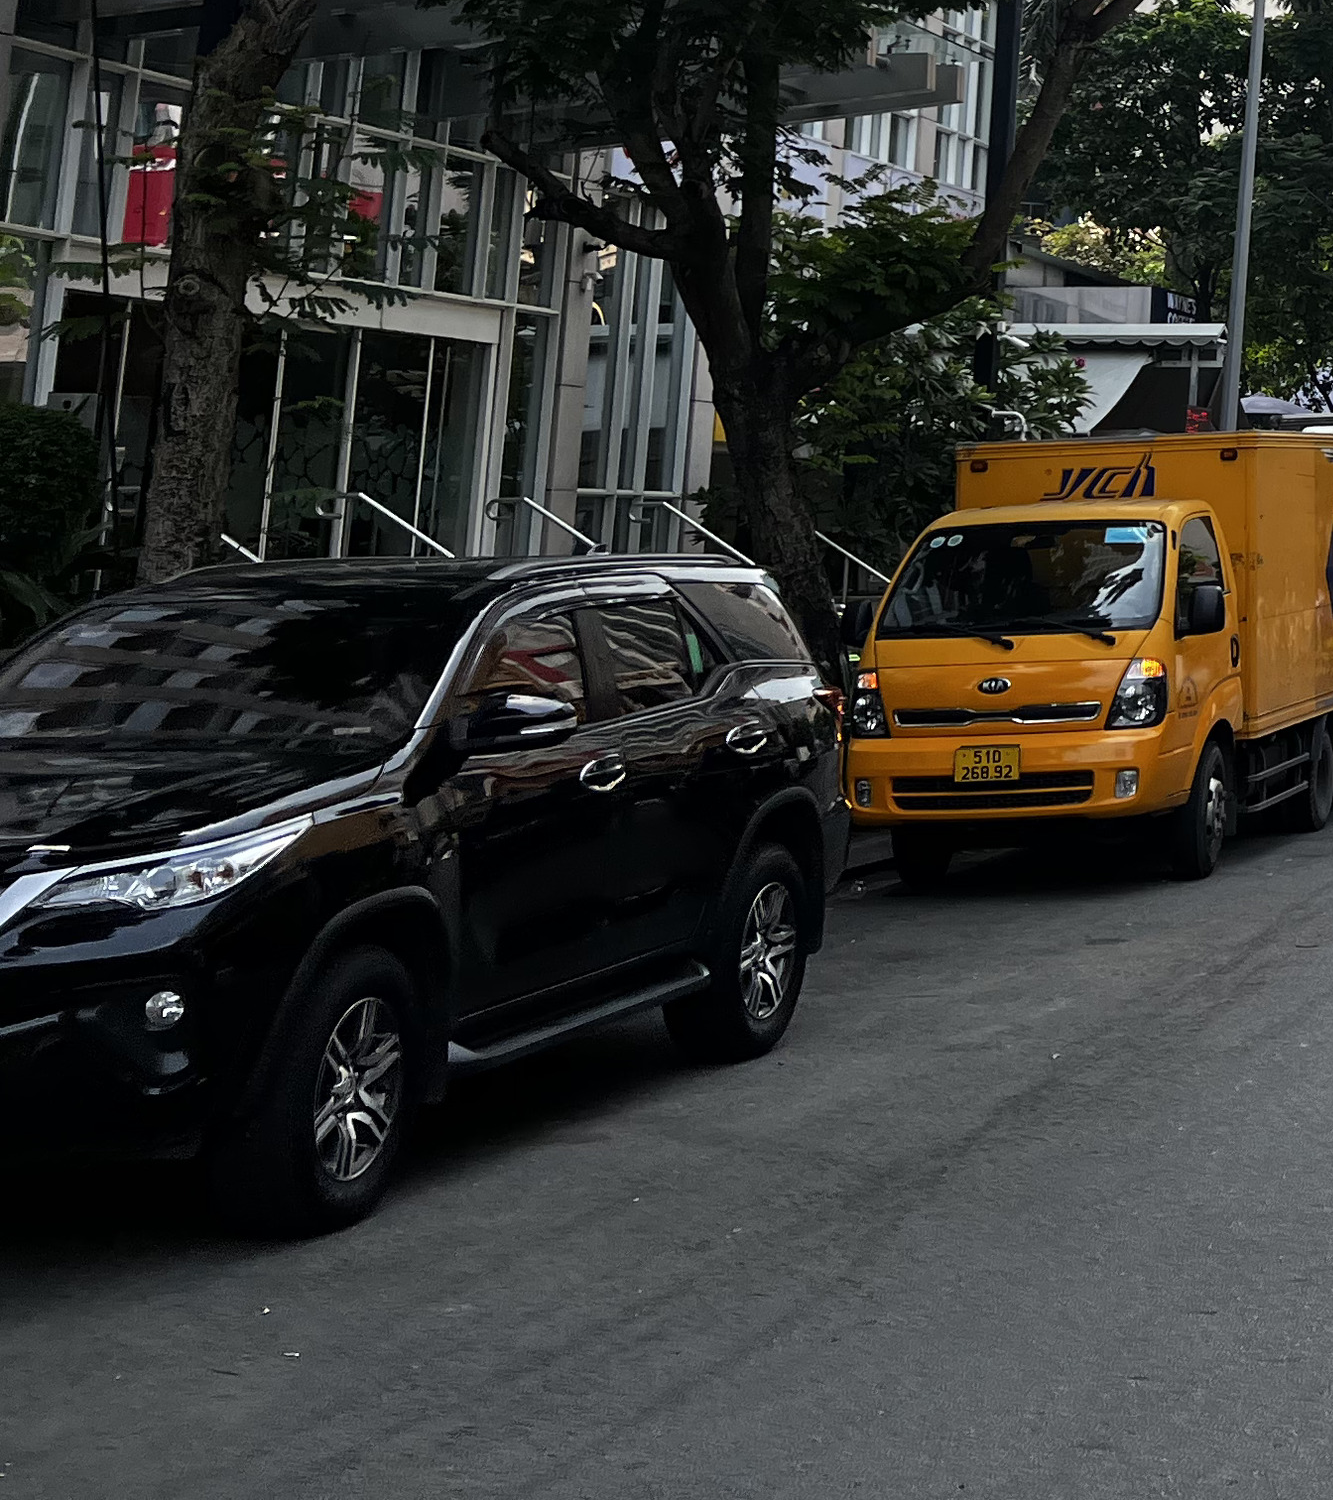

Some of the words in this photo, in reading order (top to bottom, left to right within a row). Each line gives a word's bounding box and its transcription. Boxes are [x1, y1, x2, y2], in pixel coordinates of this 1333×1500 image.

[982, 679, 1004, 691] KIA
[973, 749, 1002, 765] 51D
[961, 764, 1013, 781] 268.92
